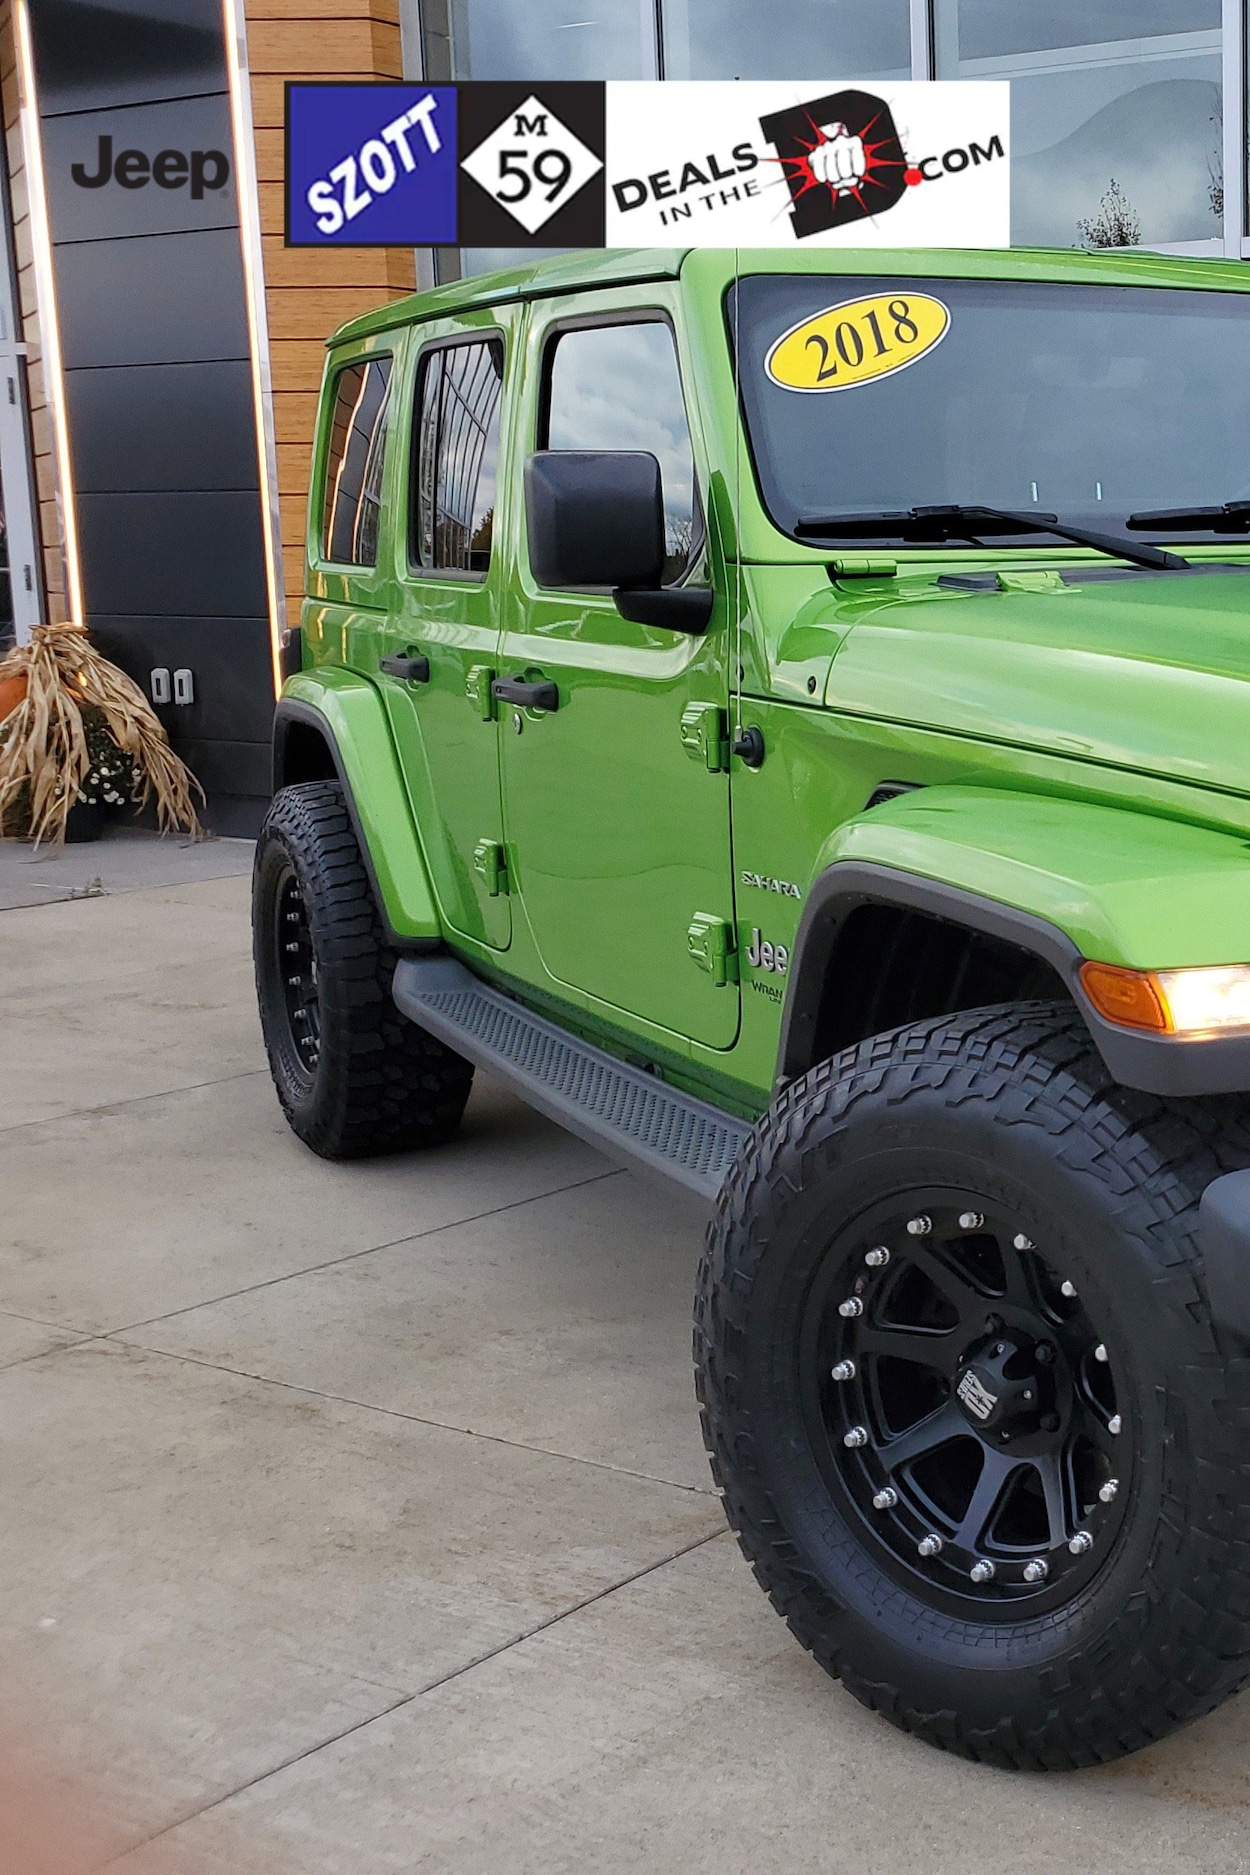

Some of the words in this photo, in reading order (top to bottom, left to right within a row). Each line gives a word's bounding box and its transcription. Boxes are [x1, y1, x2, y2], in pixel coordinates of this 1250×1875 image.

[71, 135, 230, 200] Jeep
[804, 299, 919, 382] 2018
[741, 870, 801, 900] SAHARA
[745, 927, 788, 975] Jee
[752, 980, 783, 1000] WRAN
